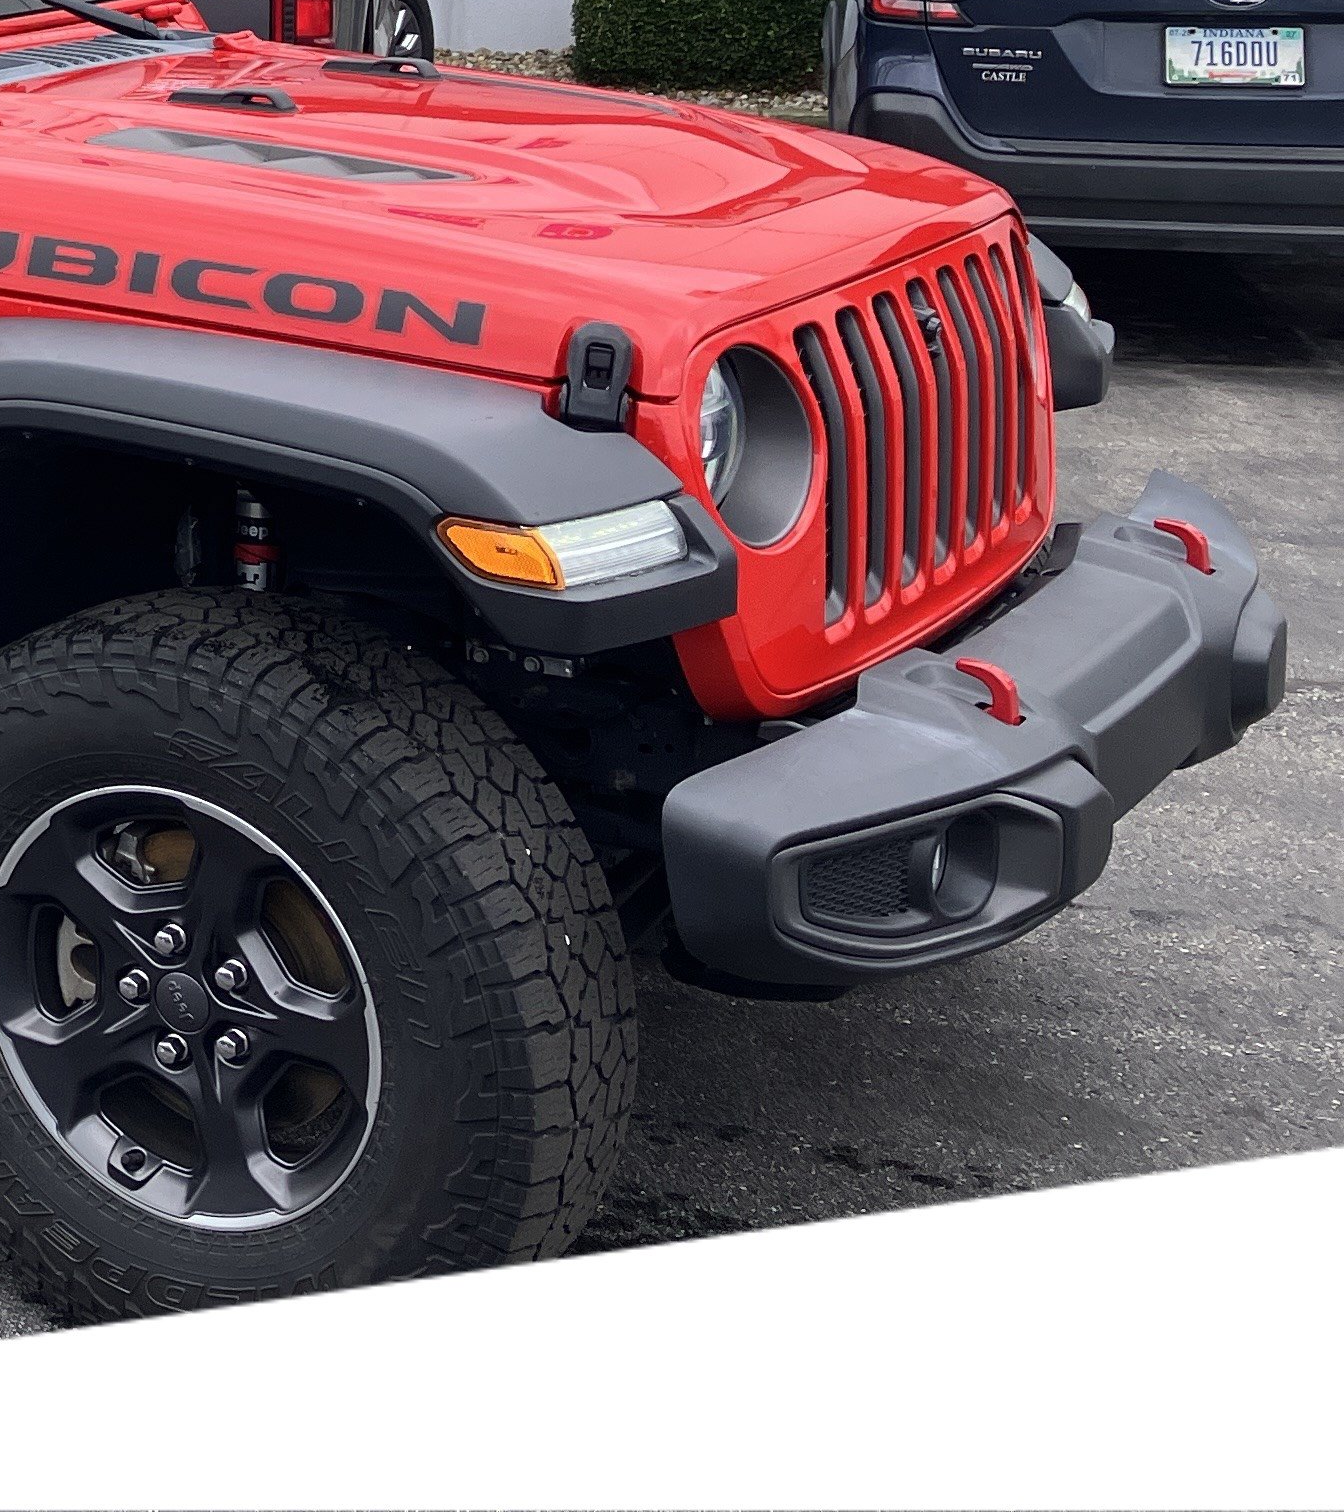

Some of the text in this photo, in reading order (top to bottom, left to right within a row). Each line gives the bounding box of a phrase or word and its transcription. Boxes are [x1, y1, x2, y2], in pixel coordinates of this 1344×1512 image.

[1203, 29, 1265, 38] INDIANA
[962, 47, 1042, 59] SUBARU
[981, 70, 1027, 83] CASTLE
